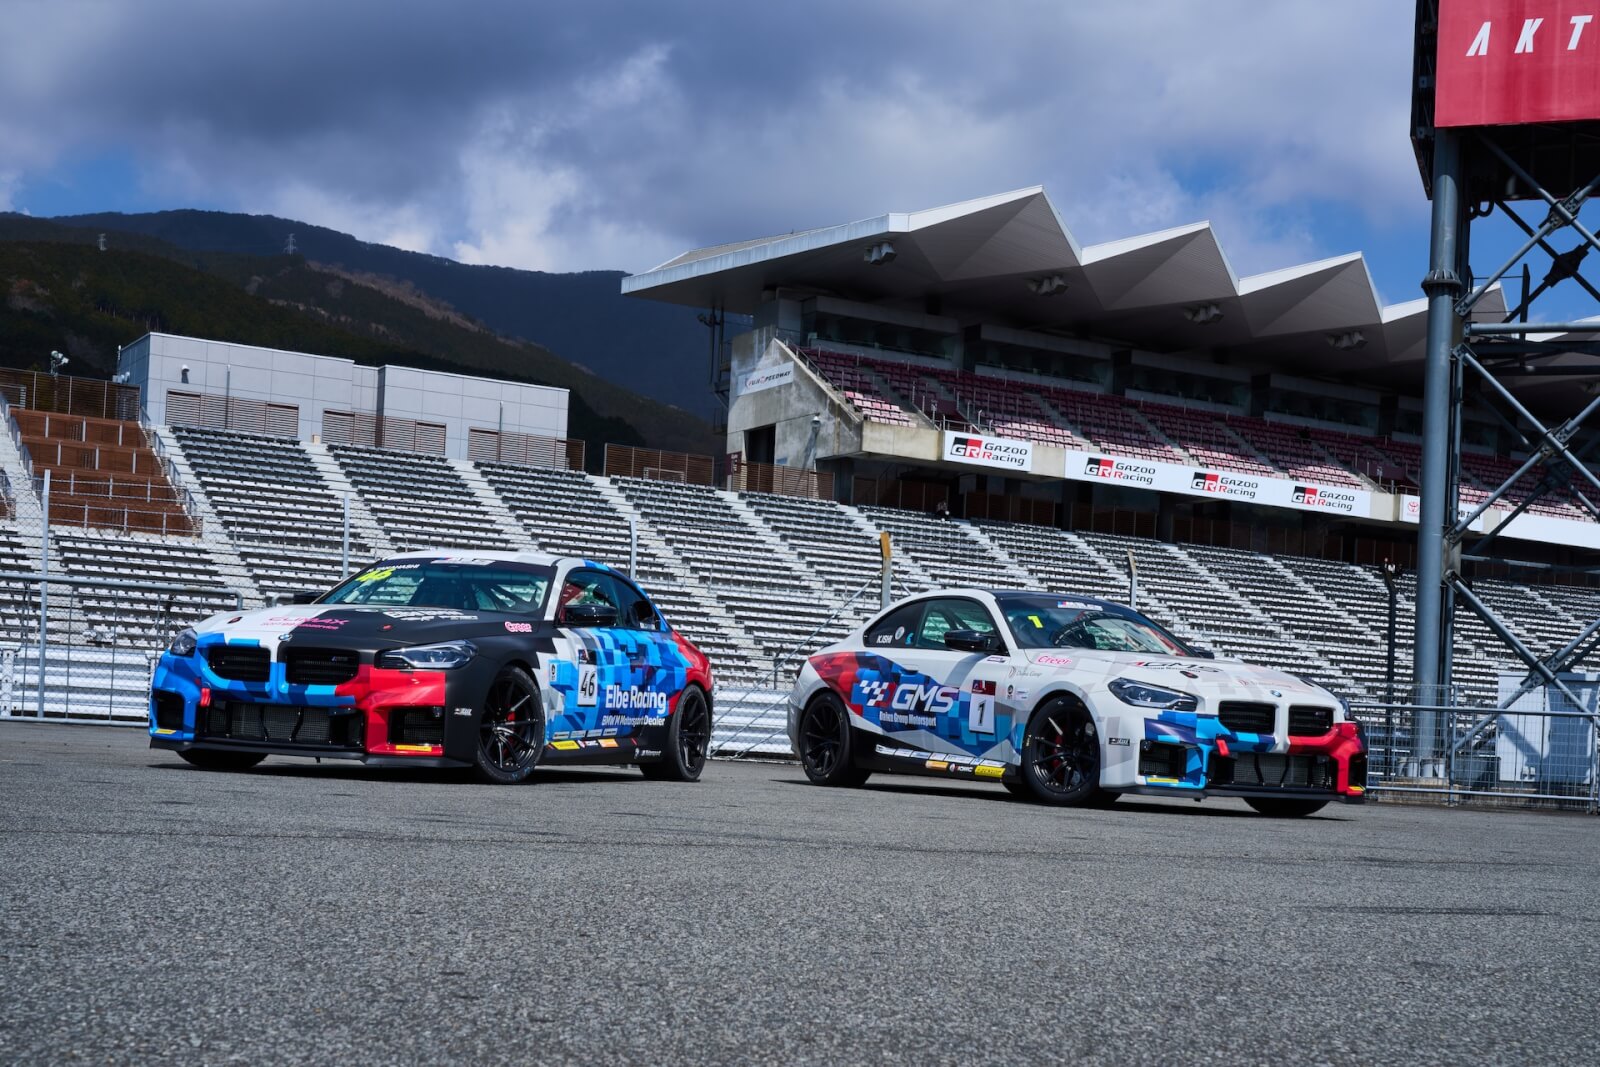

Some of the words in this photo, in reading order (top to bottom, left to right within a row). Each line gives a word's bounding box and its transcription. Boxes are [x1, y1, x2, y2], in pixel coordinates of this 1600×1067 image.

[951, 440, 981, 459] GR
[984, 442, 1028, 456] GAZOO
[982, 452, 1026, 467] Racing
[1084, 462, 1111, 478] GR
[1115, 462, 1156, 475] GAZOO
[1113, 471, 1154, 485] Racing
[1191, 477, 1217, 493] GR
[1220, 477, 1259, 490] GAZOO
[1218, 485, 1256, 499] Racing
[1291, 491, 1317, 506] GR
[1319, 490, 1355, 502] GAZOO
[1317, 499, 1353, 512] Racing
[1027, 615, 1044, 629] 1
[579, 670, 596, 698] 46
[605, 684, 629, 709] Elbe
[629, 685, 667, 718] Racing
[891, 683, 959, 713] GMS
[644, 714, 665, 726] Dealer
[977, 700, 986, 727] 1
